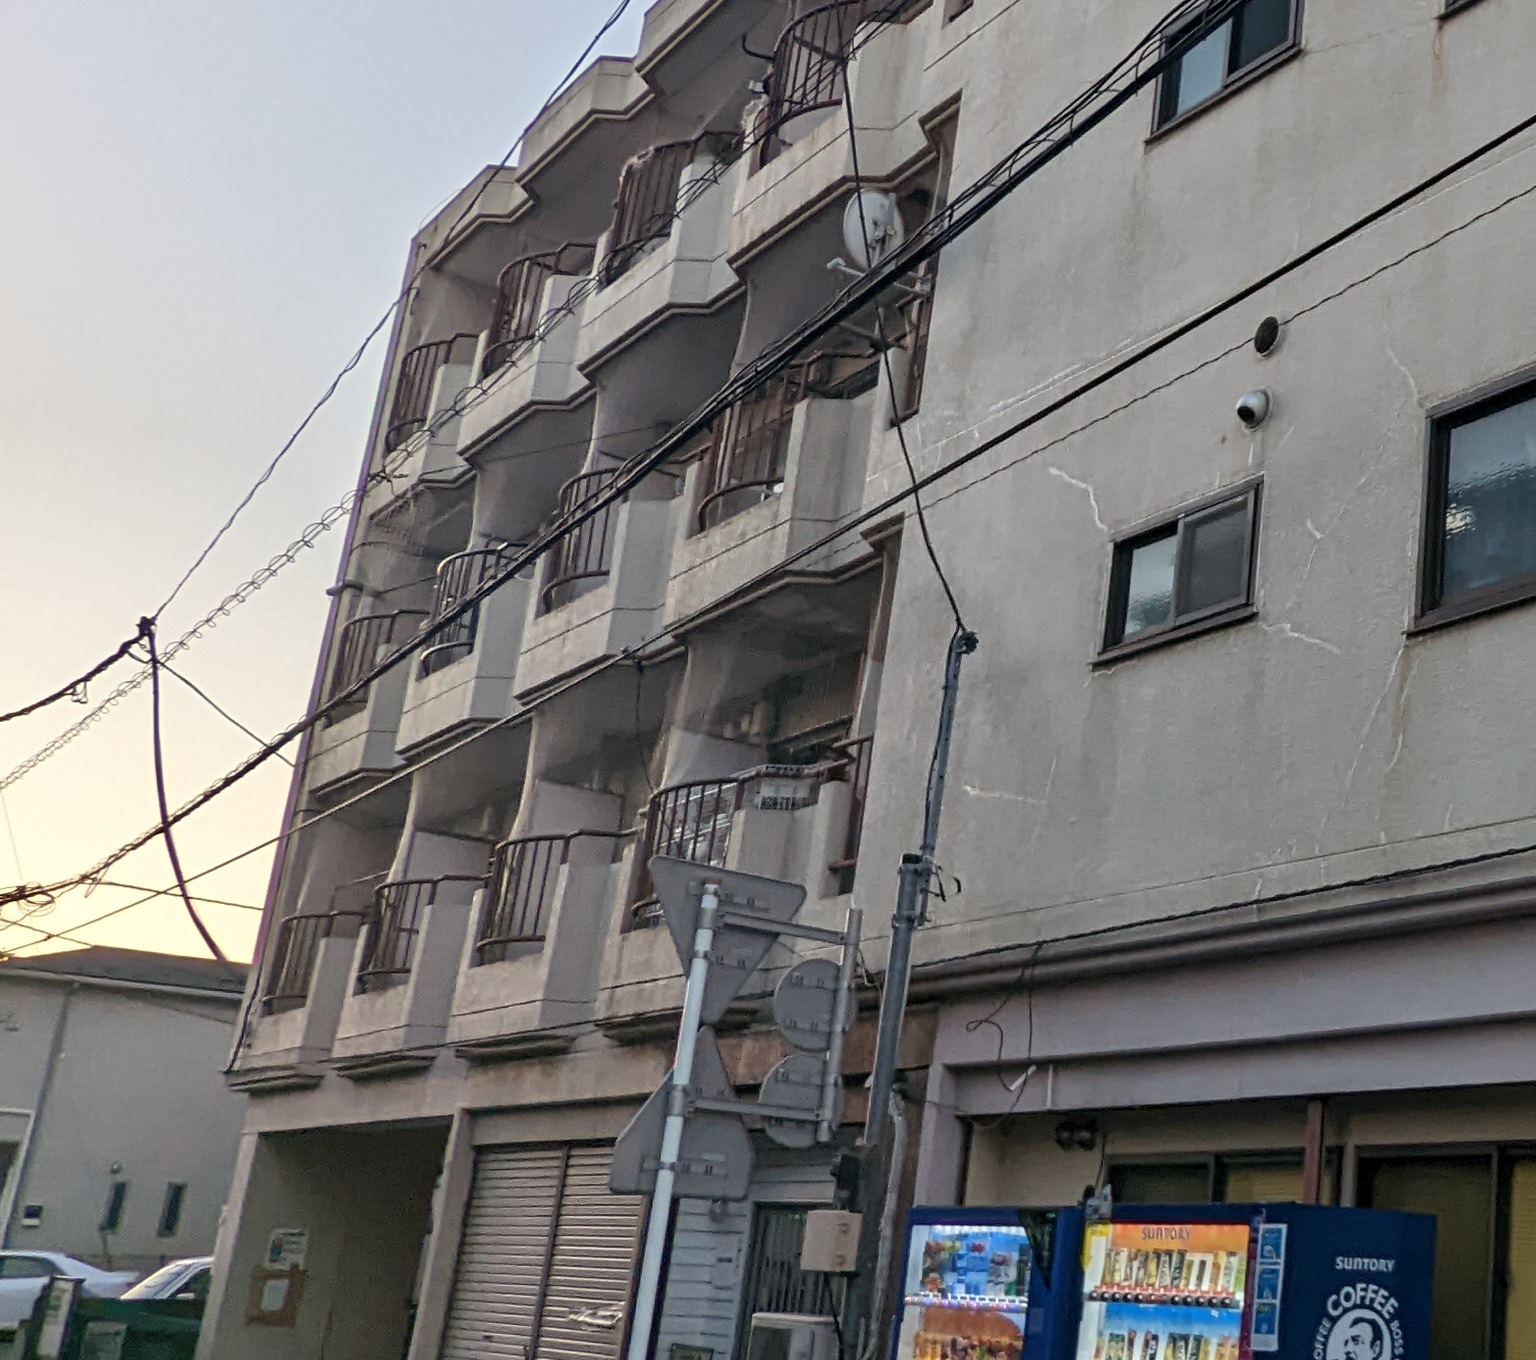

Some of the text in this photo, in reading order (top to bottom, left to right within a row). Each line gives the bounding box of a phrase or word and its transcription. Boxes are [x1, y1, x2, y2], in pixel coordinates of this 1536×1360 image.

[1141, 1226, 1192, 1241] SUNTORY
[1334, 1256, 1396, 1272] SUNTORY
[1326, 1283, 1400, 1320] COFFEE
[1389, 1319, 1404, 1356] BOSS
